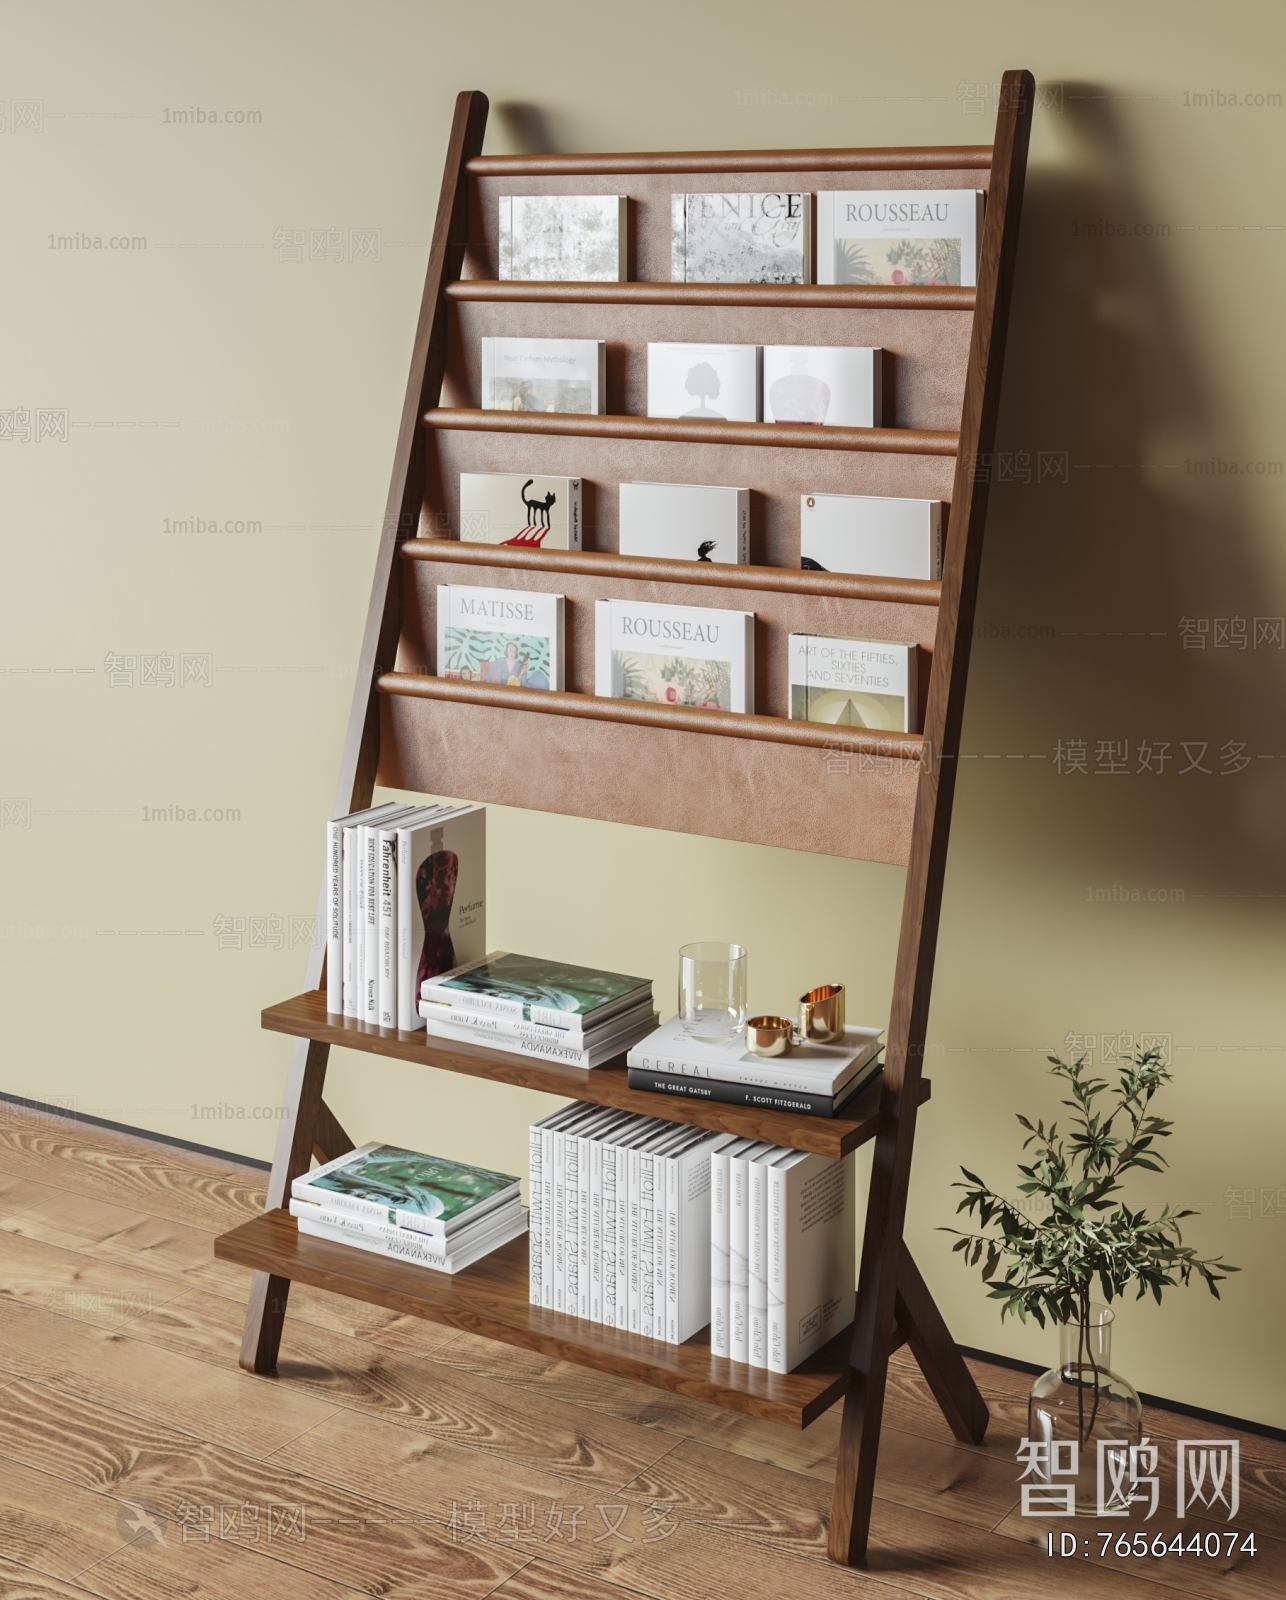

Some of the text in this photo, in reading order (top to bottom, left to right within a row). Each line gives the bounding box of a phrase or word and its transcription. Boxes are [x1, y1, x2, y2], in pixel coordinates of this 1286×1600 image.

[845, 203, 950, 222] ROUSSEAU
[503, 354, 577, 366] Near Eastern Mythology
[460, 597, 534, 621] MATISSE
[621, 616, 720, 644] ROUSSEAU
[798, 645, 817, 657] ART
[820, 647, 836, 658] OF
[839, 649, 857, 661] THE
[831, 660, 867, 674] SIXTIES
[807, 669, 832, 681] AND
[834, 673, 889, 688] SEVENTIES
[367, 837, 375, 925] BEST EDUCATION FOR BEST LIFE
[382, 839, 392, 918] Fahrenheit 451
[332, 897, 339, 907] OF
[459, 900, 484, 916] Perfume
[641, 1058, 713, 1079] CEREAL
[654, 1081, 712, 1096] THE GREAT GATSBY
[745, 1094, 812, 1110] F. SCOTT FITZGERALD
